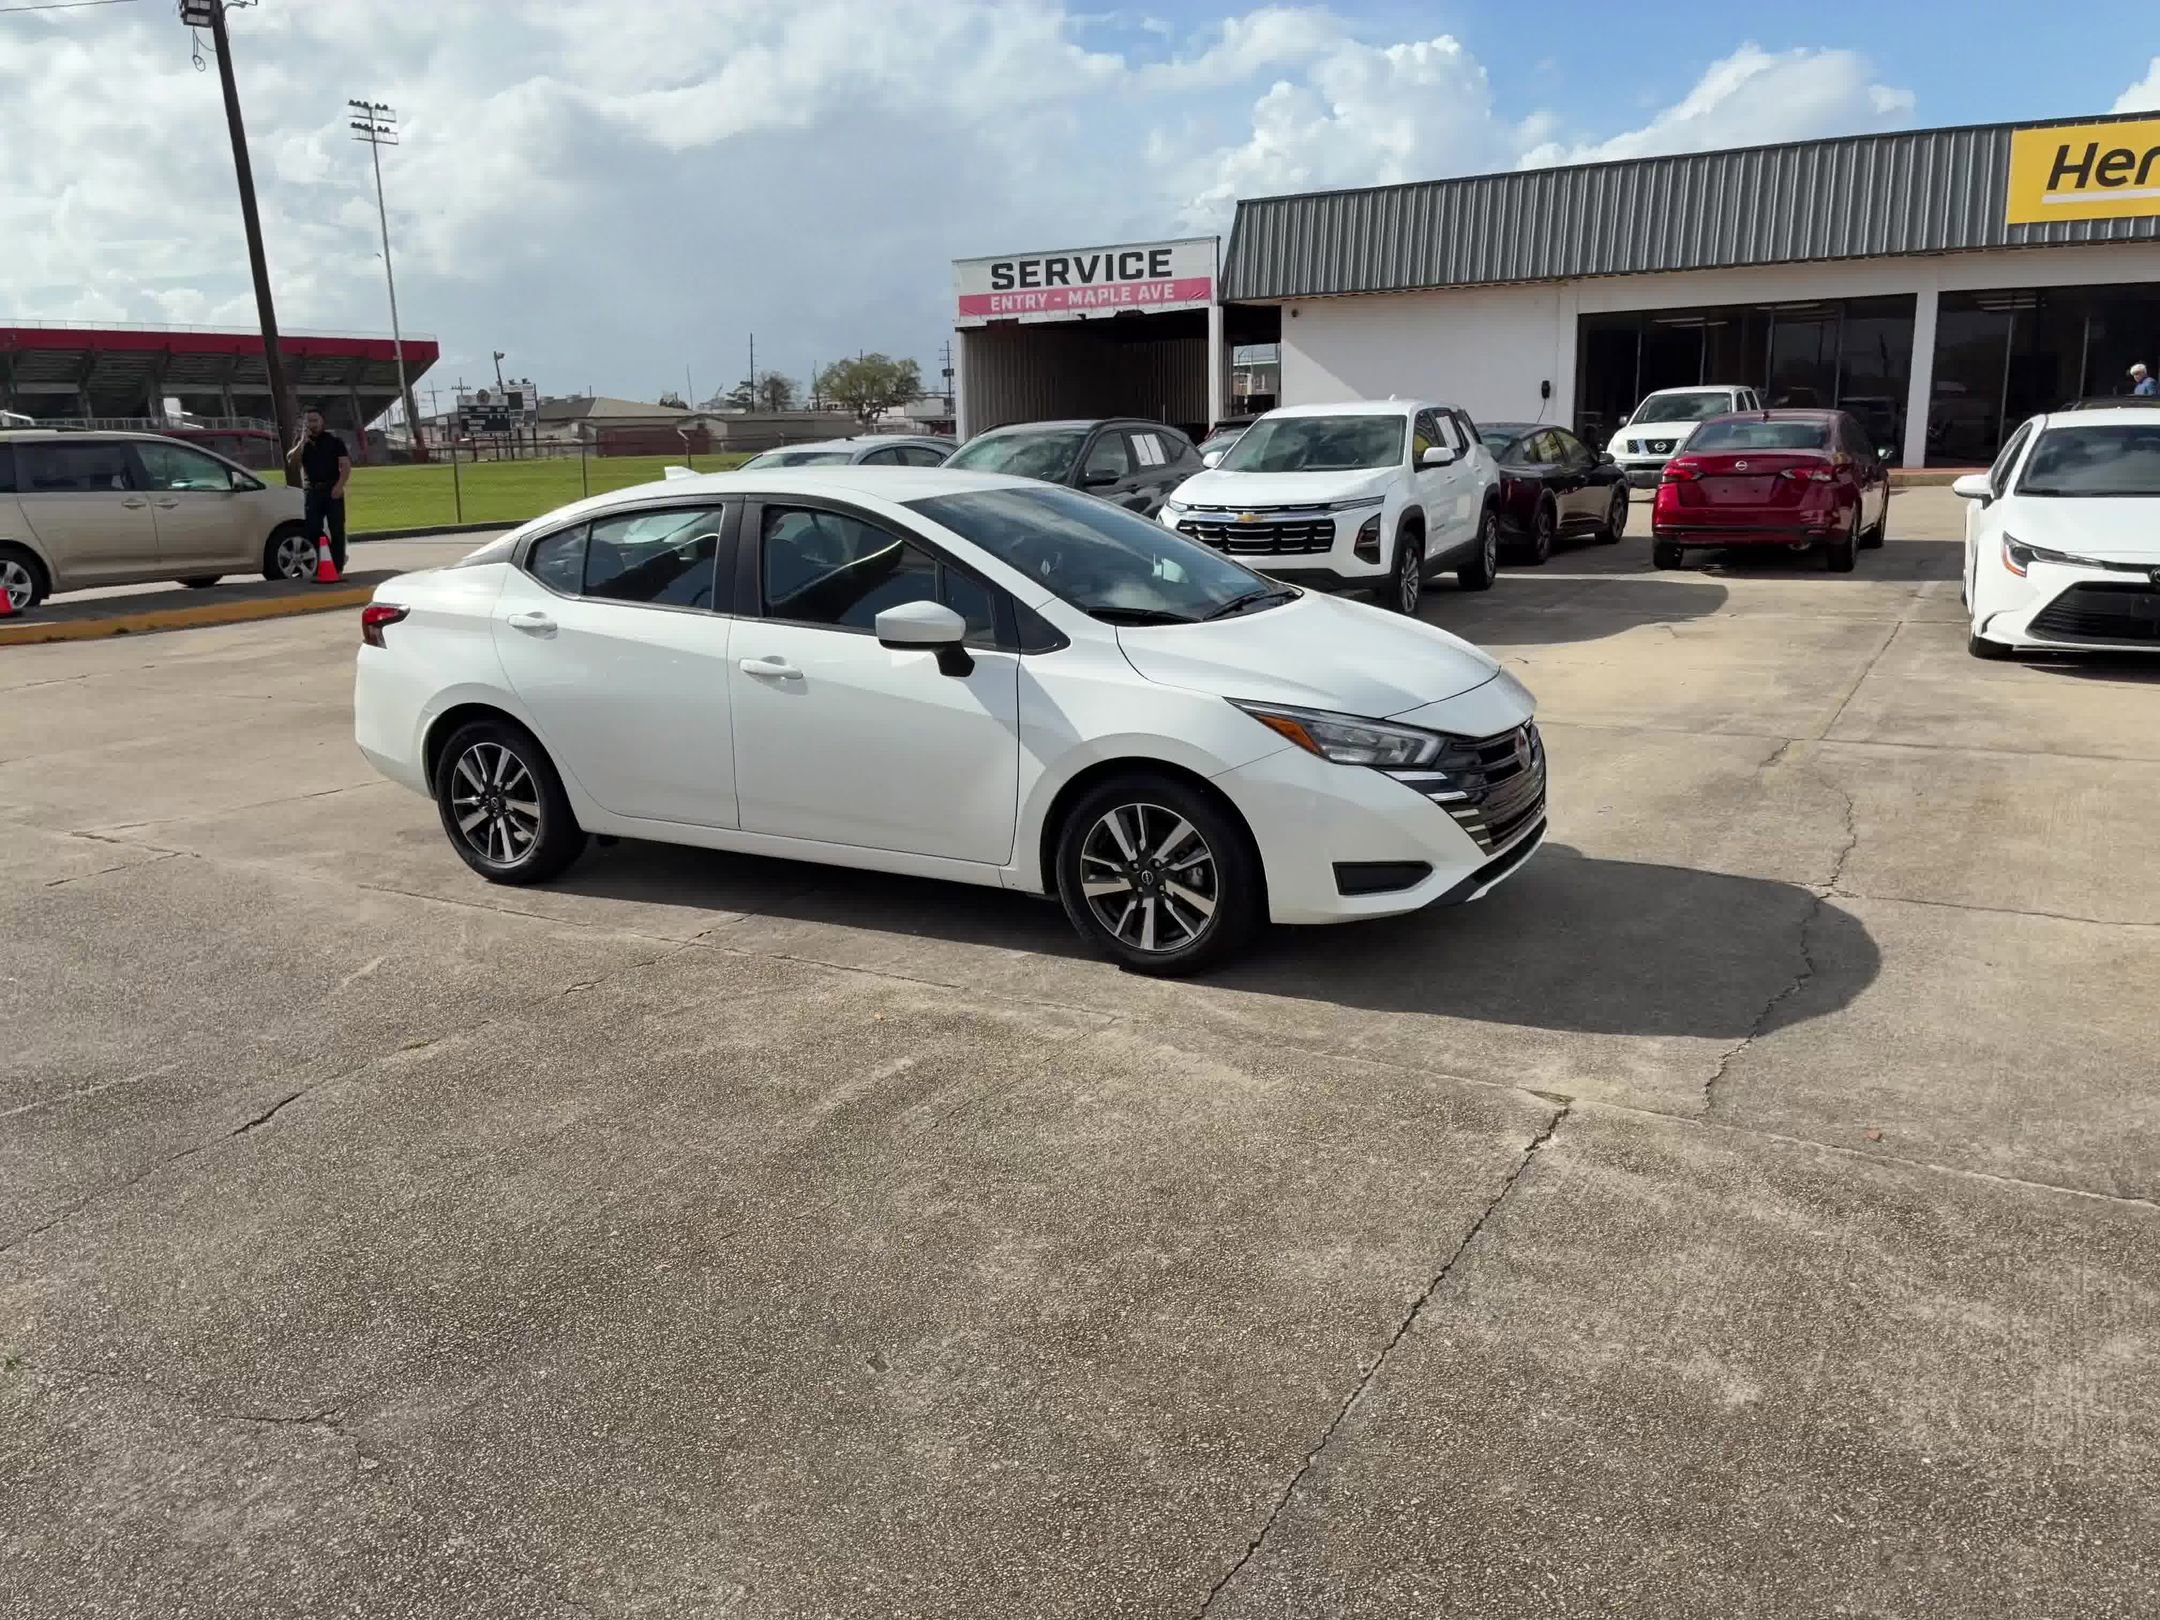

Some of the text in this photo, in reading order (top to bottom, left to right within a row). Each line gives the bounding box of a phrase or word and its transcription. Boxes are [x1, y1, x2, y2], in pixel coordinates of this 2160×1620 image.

[2046, 142, 2160, 191] Her
[992, 250, 1173, 290] SERVICE
[990, 294, 1048, 312] ENTRY
[1068, 287, 1132, 306] MAPLE
[1138, 283, 1175, 300] AVE
